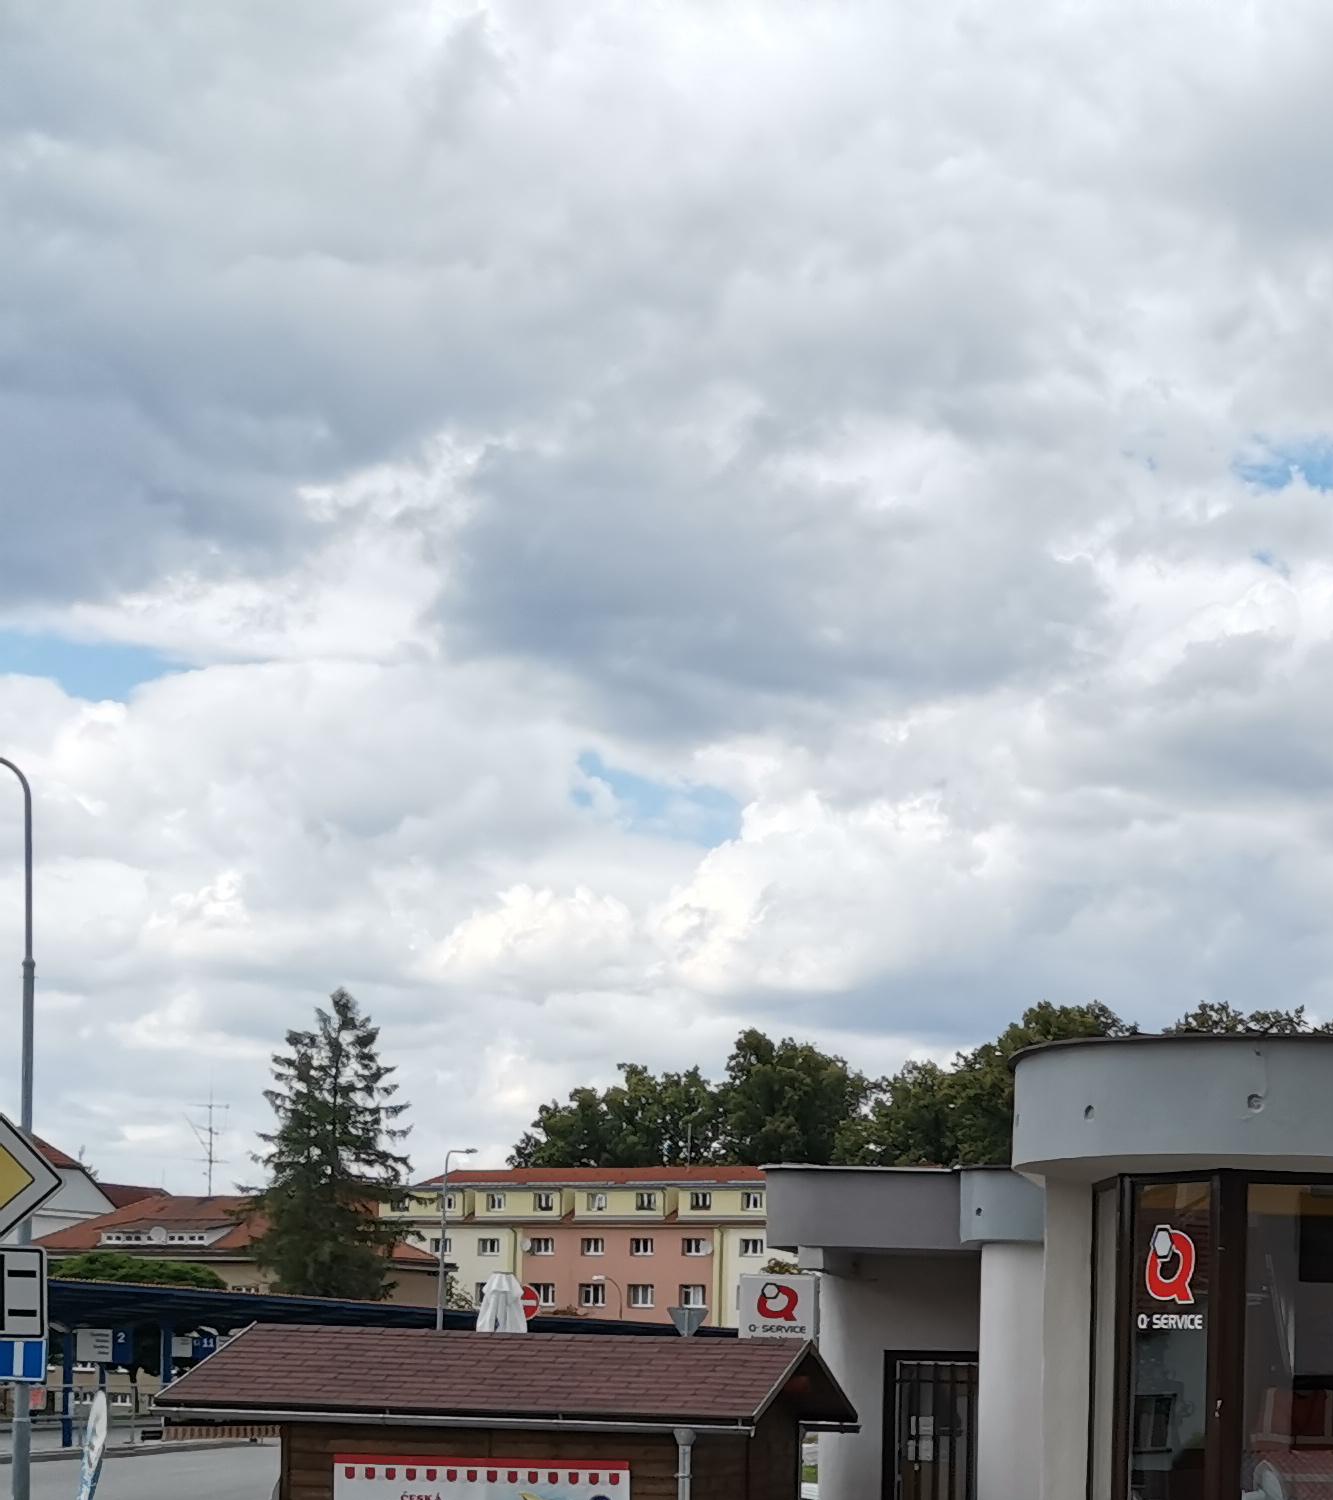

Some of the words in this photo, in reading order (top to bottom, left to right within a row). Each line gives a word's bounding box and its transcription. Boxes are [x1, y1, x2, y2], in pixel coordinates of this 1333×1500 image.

[1152, 1314, 1203, 1330] SERVICE
[761, 1324, 807, 1334] SERVICE
[116, 1332, 126, 1343] 2
